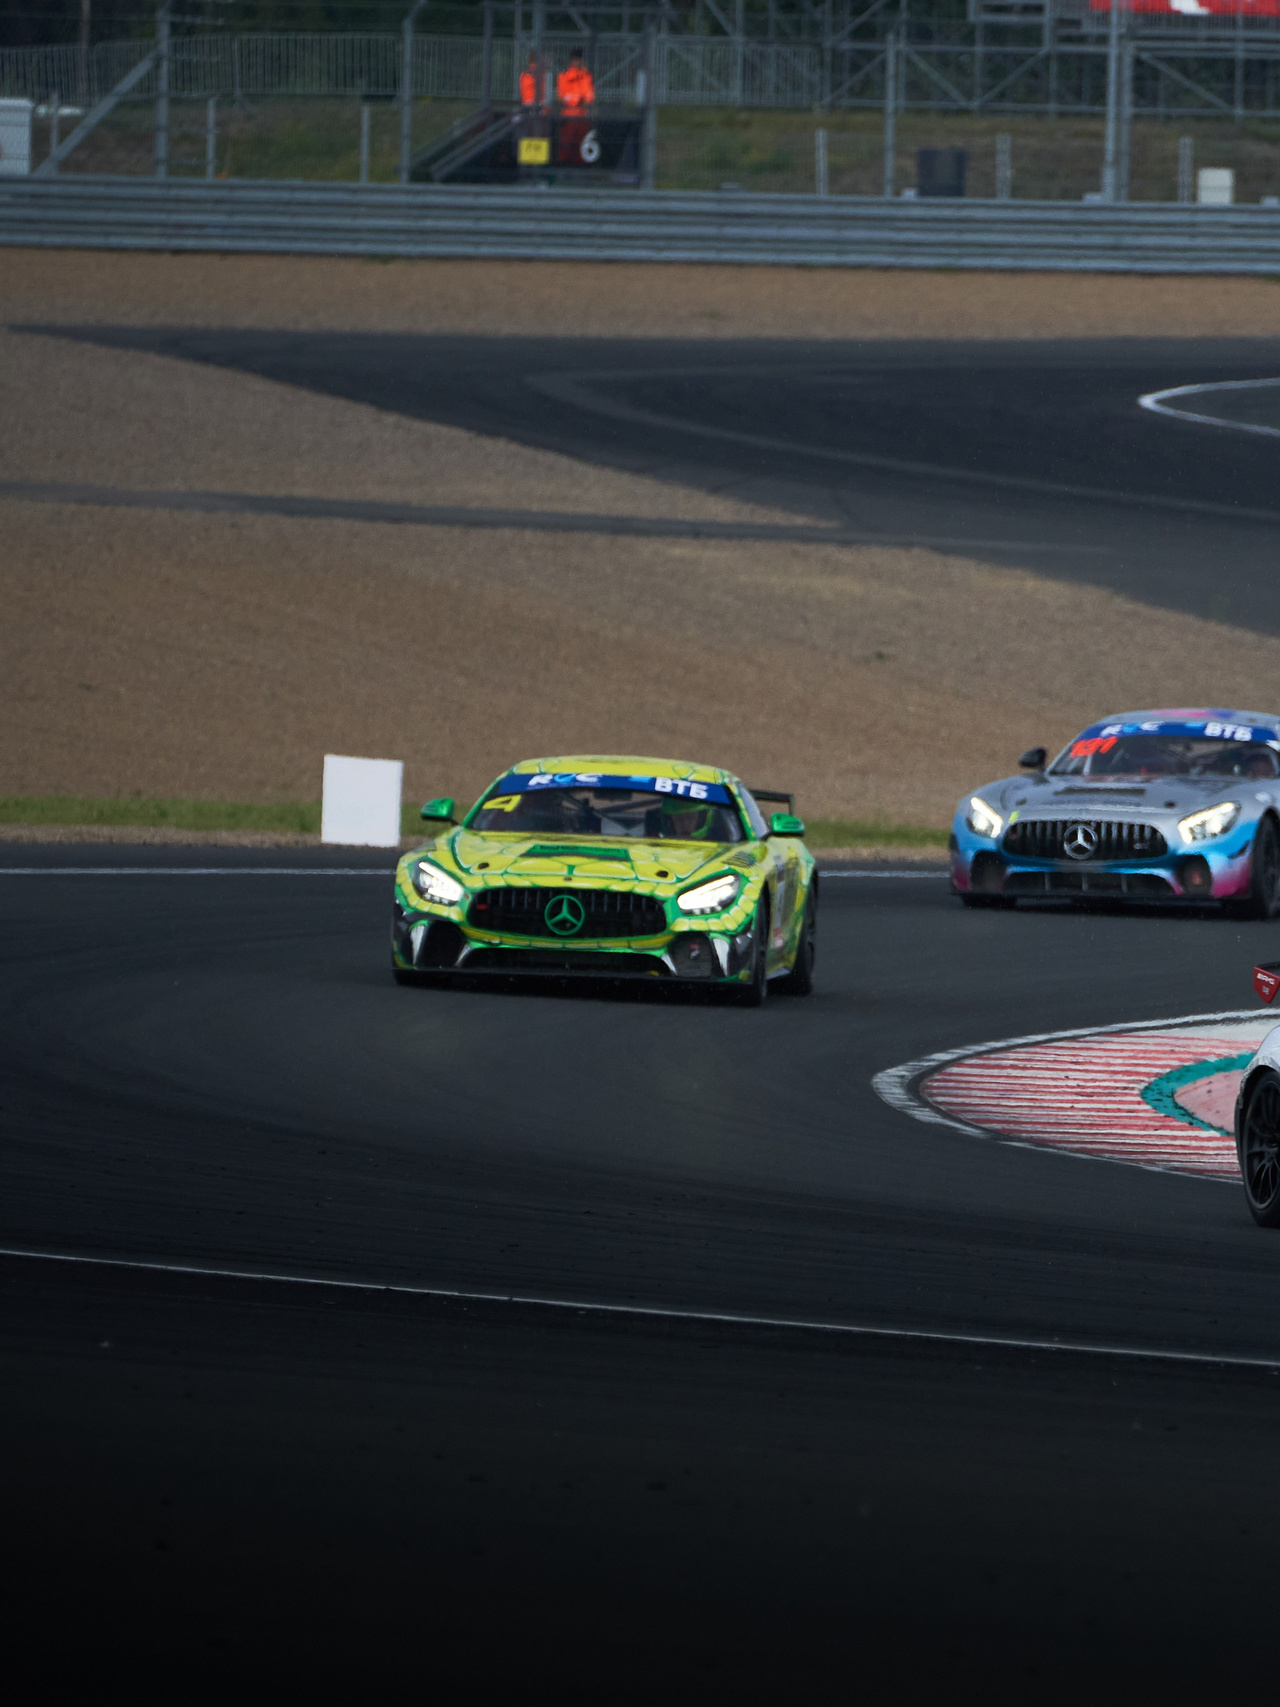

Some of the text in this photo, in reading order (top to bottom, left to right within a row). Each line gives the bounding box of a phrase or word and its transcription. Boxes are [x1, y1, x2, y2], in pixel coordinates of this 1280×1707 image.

[580, 128, 600, 163] 6
[1204, 721, 1252, 742] ВТБ
[654, 777, 709, 799] ВТБ
[482, 794, 522, 813] 4
